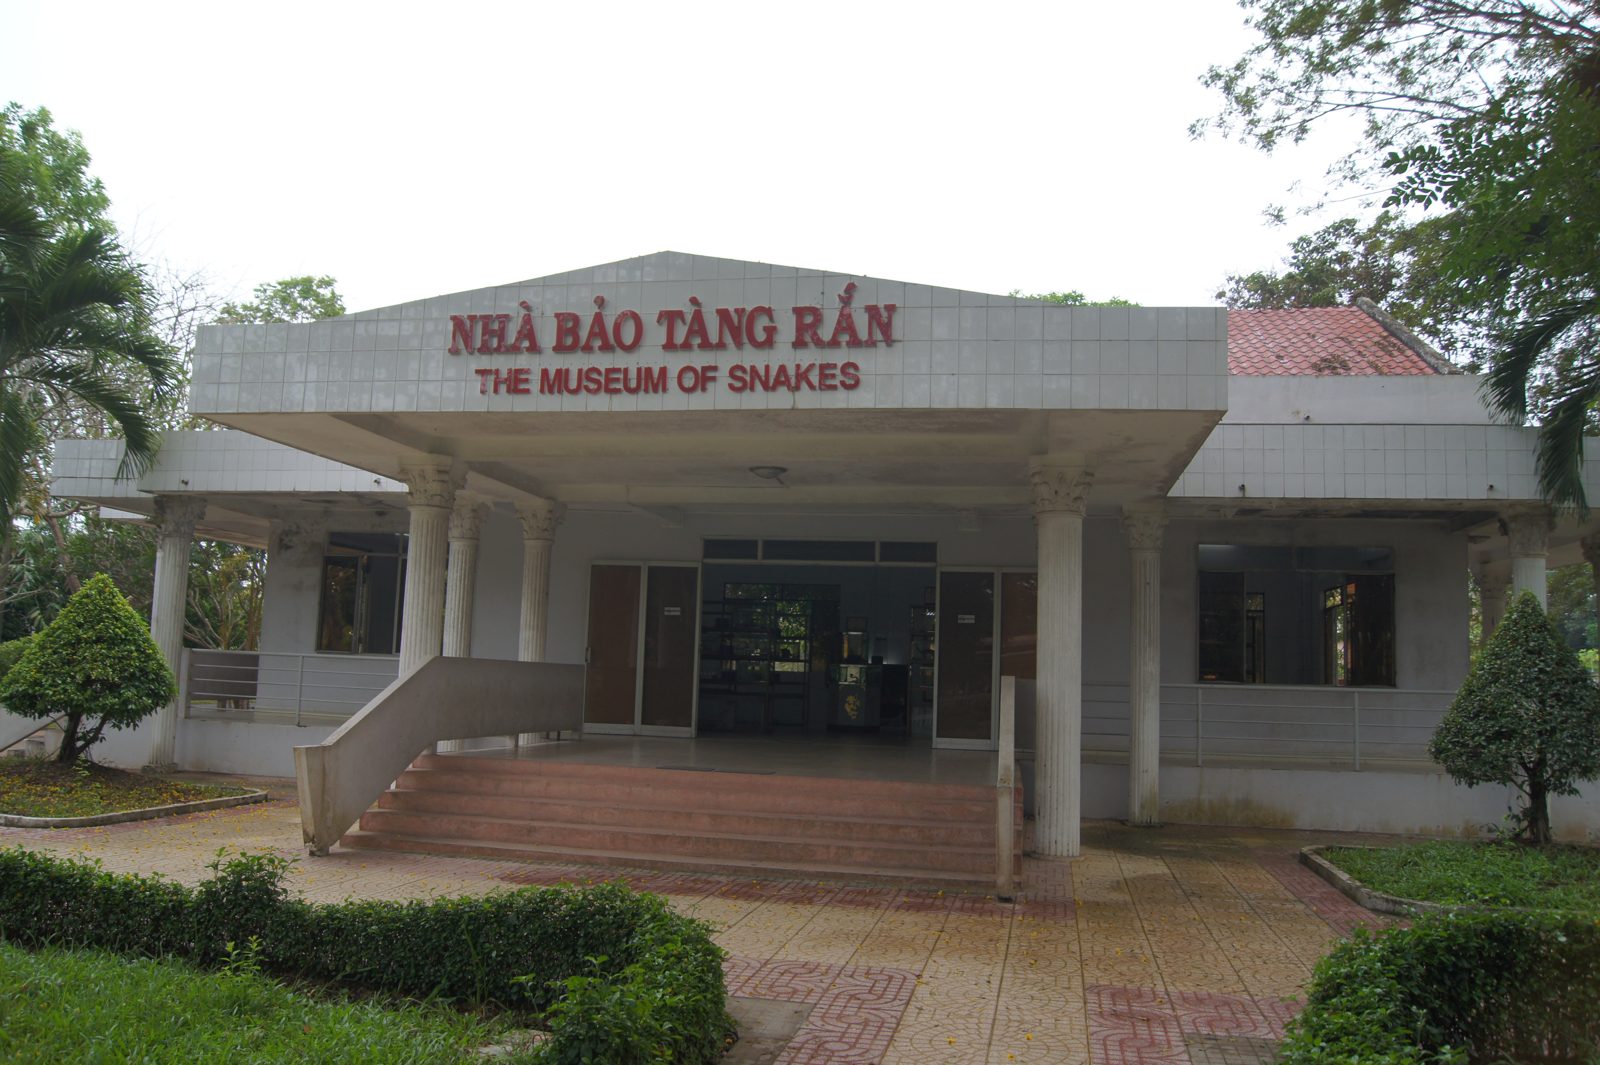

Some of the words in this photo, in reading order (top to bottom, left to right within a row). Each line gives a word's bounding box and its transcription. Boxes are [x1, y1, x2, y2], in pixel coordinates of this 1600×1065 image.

[448, 300, 542, 354] NHÀ
[552, 295, 645, 353] BẢO
[656, 295, 778, 351] TÀNG
[475, 367, 532, 395] THE
[539, 366, 668, 396] MUSEUM
[676, 364, 719, 394] OF
[727, 361, 862, 394] SNAKES
